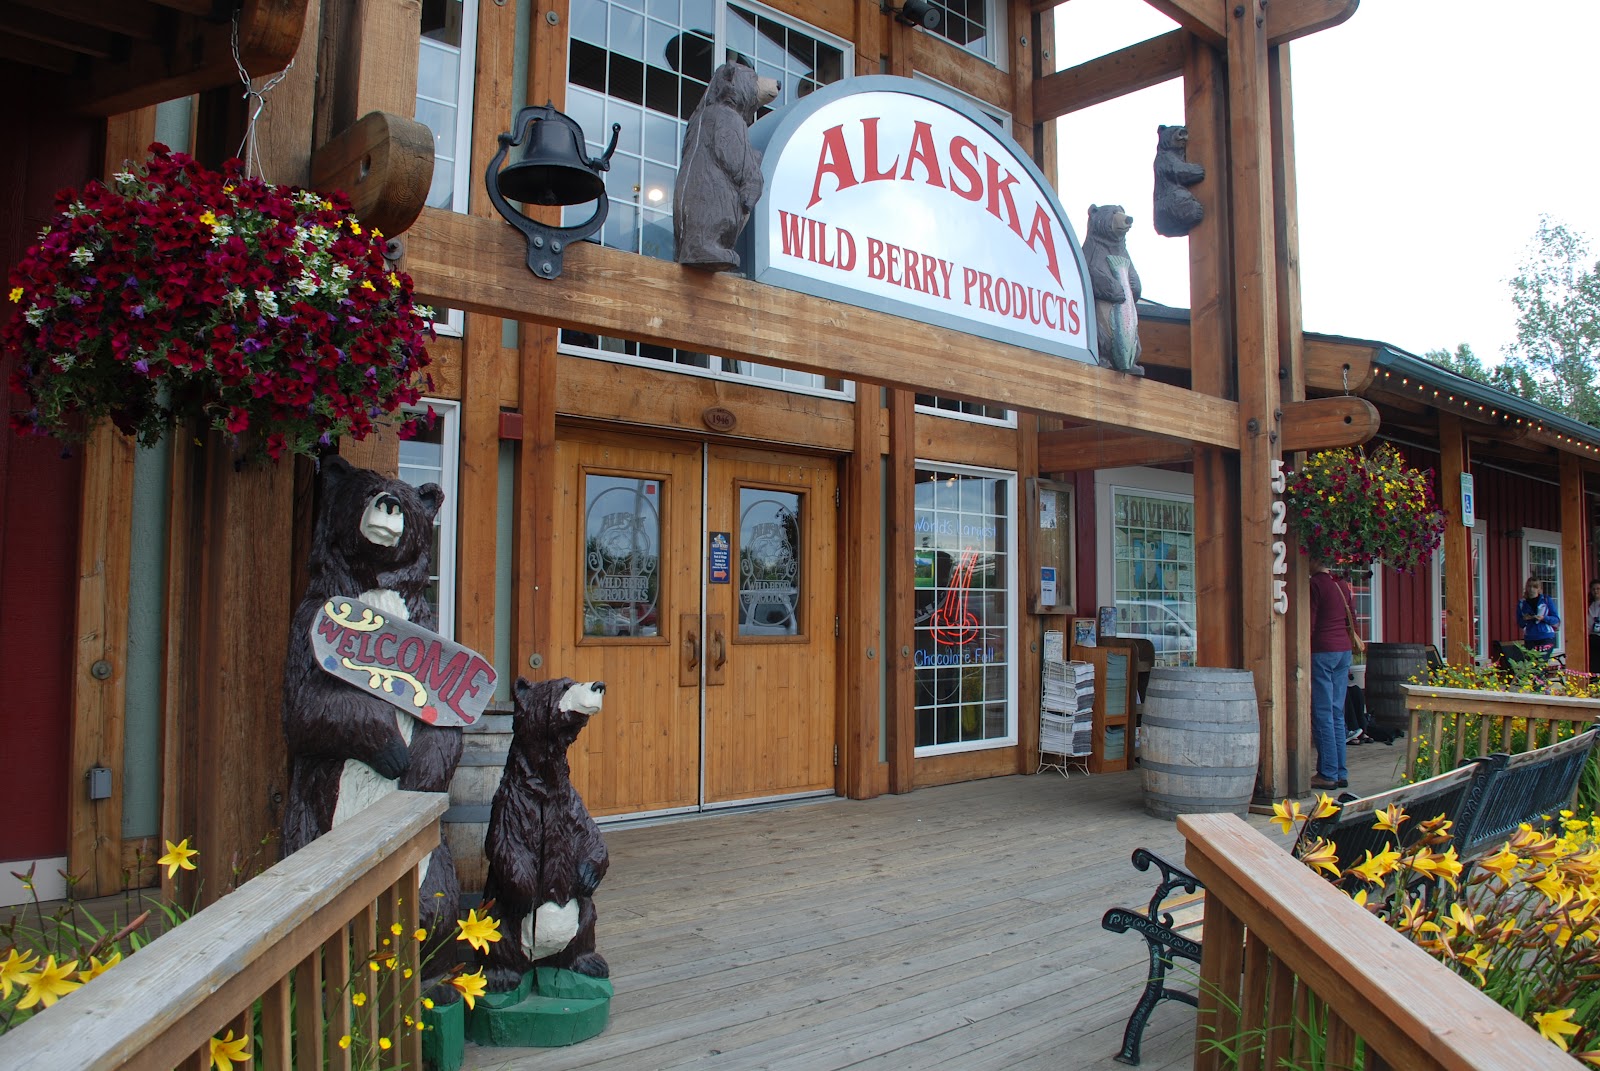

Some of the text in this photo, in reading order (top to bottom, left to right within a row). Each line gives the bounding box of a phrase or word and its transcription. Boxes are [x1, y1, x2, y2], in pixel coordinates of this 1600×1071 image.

[806, 117, 1064, 290] ALASKA
[778, 209, 1081, 336] WILD BERRY PRODUCTS
[914, 516, 997, 541] World's Largest
[1123, 498, 1190, 531] SOUVENIRS
[1271, 460, 1288, 614] 5225
[317, 615, 497, 724] WELCOME
[975, 647, 994, 664] Fall
